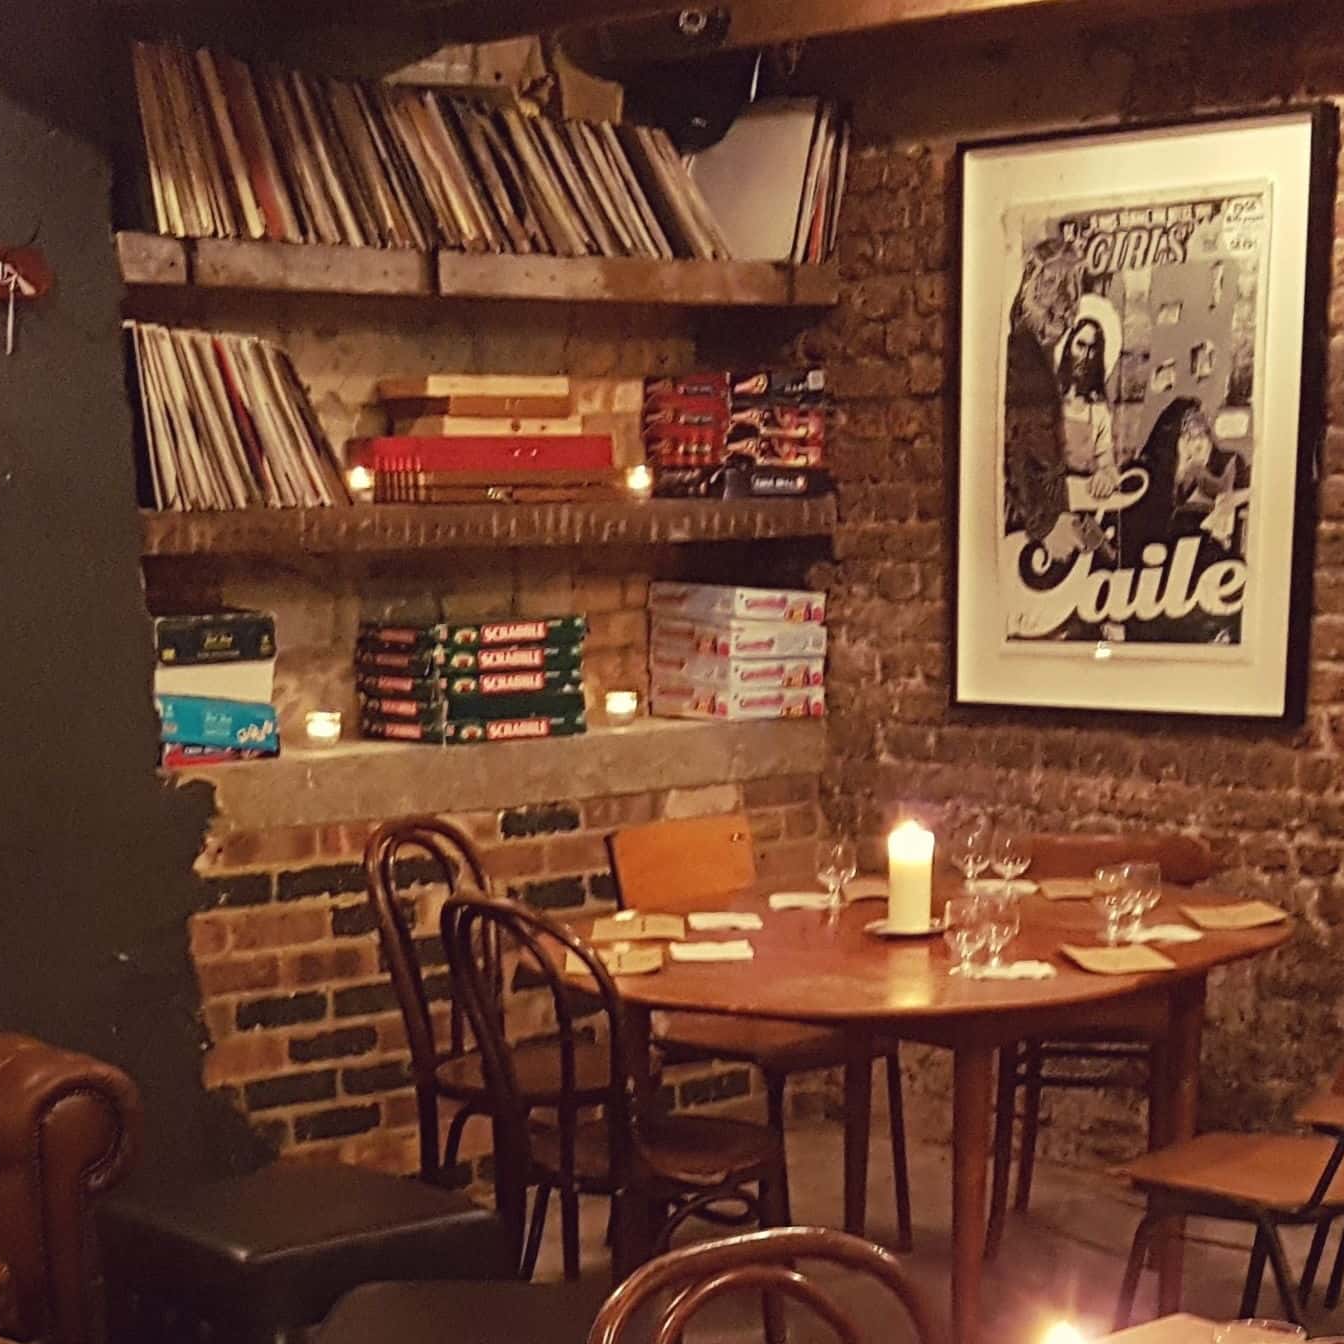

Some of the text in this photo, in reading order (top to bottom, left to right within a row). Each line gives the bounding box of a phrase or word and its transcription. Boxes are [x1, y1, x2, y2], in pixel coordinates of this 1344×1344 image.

[482, 622, 546, 641] SCRABBLE
[480, 650, 543, 667] SCRABBLE
[482, 672, 544, 692] SCRABBLE
[488, 720, 550, 739] SCRABBLE
